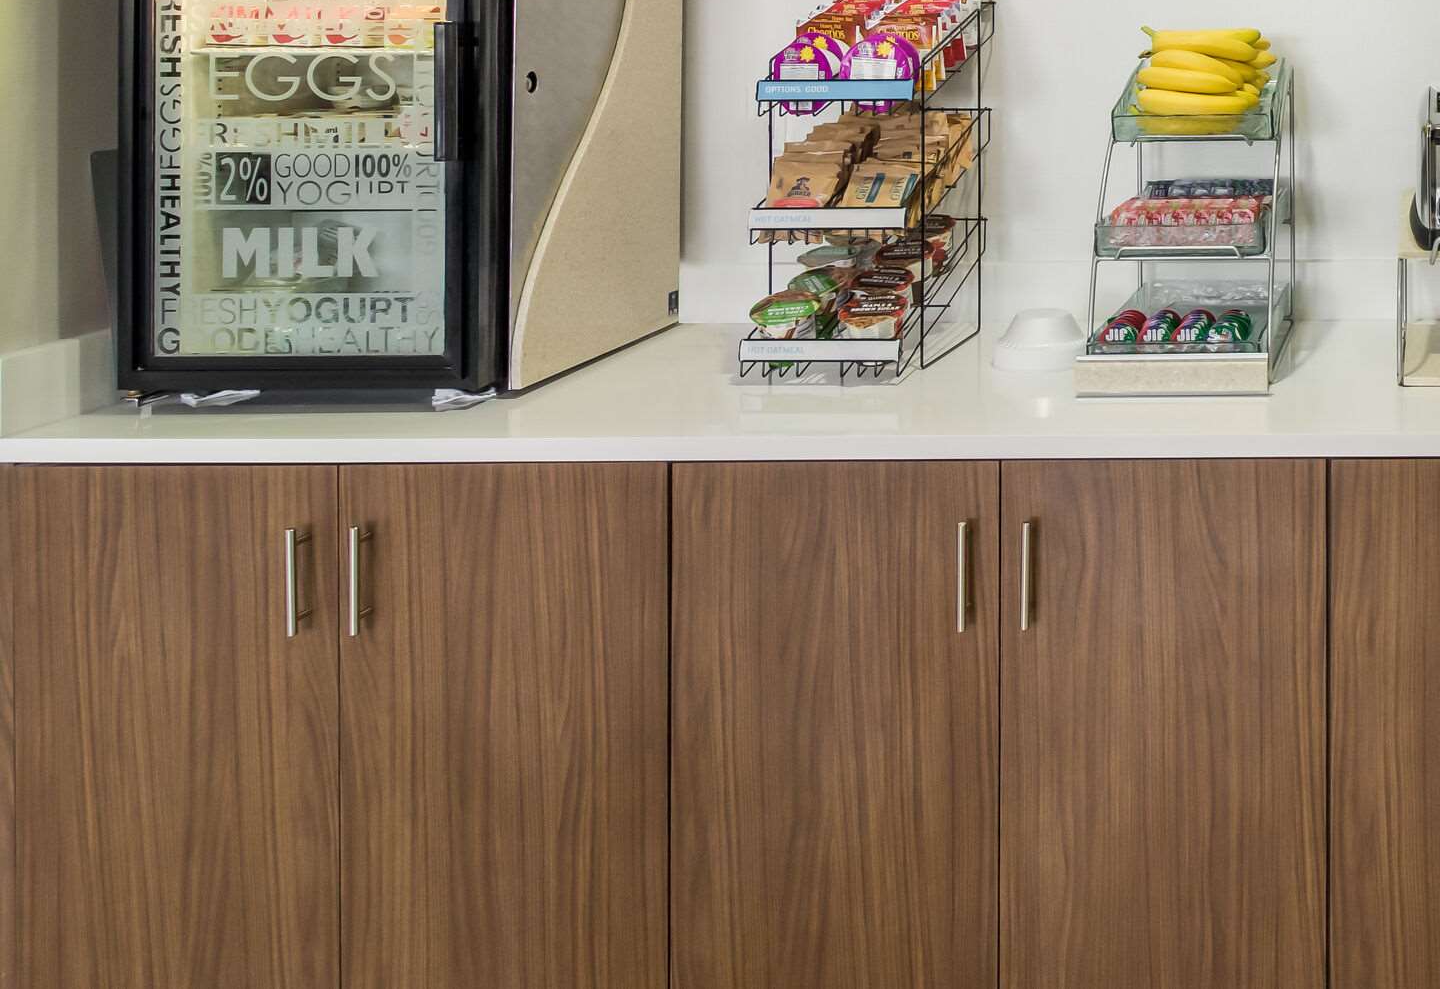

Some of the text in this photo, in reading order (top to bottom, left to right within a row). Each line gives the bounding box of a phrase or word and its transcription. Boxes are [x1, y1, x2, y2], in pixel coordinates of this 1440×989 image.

[209, 51, 397, 102] EGGS
[216, 153, 413, 202] 2% GOOD 100%
[160, 174, 182, 297] HEALTHY
[223, 227, 379, 278] MILK
[262, 297, 416, 325] YOGURT
